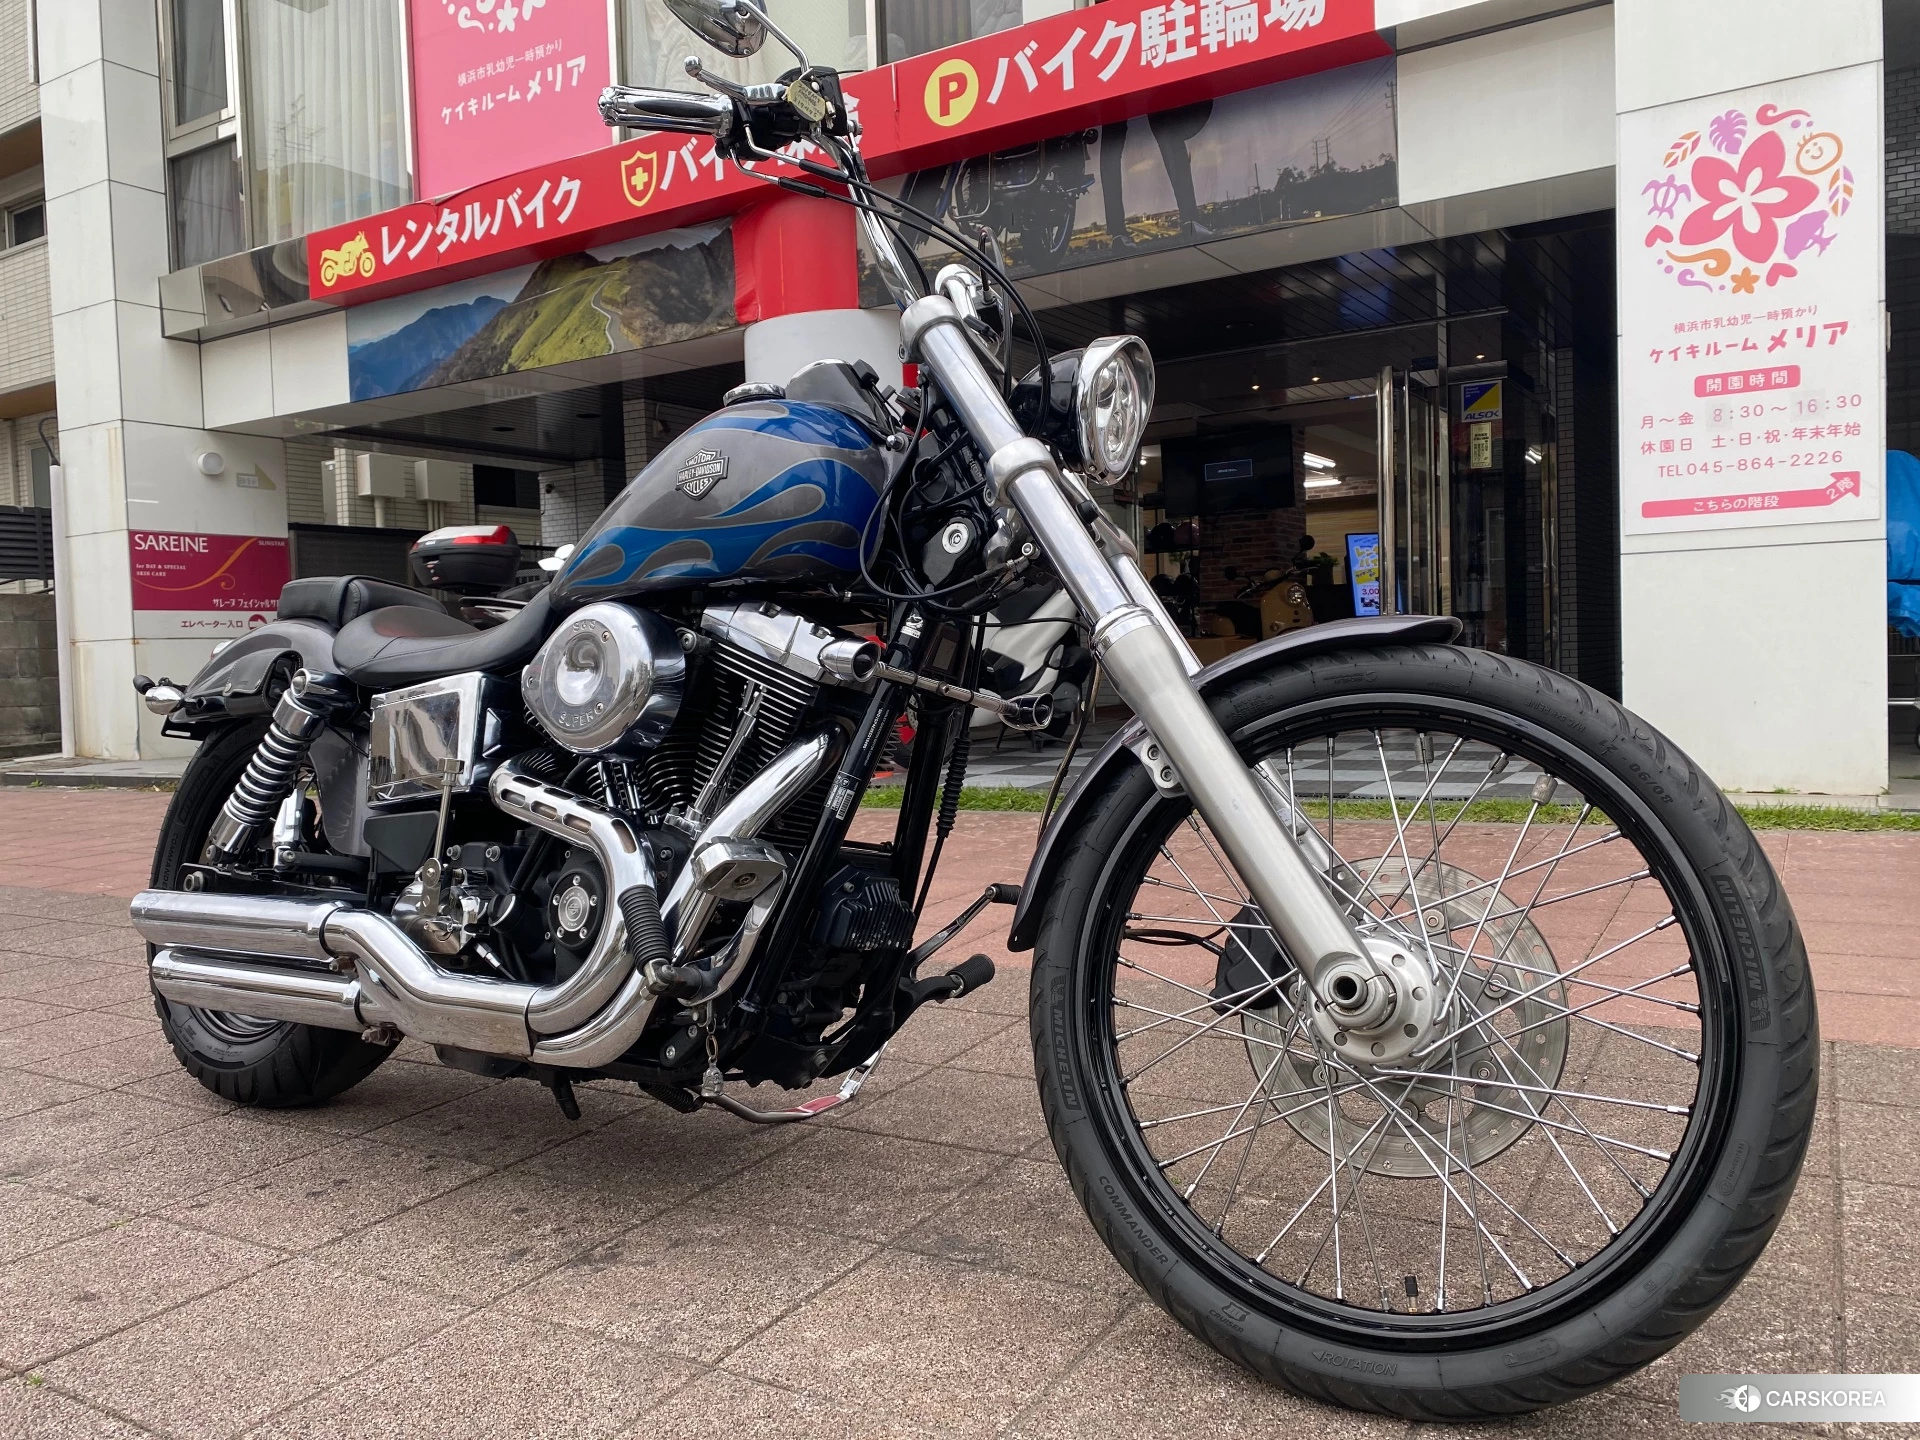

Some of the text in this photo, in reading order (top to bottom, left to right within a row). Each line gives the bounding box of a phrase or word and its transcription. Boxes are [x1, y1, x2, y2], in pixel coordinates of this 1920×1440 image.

[457, 38, 562, 87] 横浜市乳幼児一時預かり
[381, 175, 582, 266] レンタルバイク
[1673, 304, 1818, 334] 横浜市乳幼児一時預かり
[1706, 370, 1788, 393] 開園時間
[1640, 437, 1693, 455] 休園日
[686, 478, 709, 494] CYCLES
[1692, 495, 1780, 513] こちらの階段
[134, 533, 209, 553] SAREINE
[181, 619, 244, 629] エレベーター入口
[1716, 880, 1763, 992] MICHELIN
[1053, 1008, 1078, 1110] MICHELIN
[1099, 1174, 1169, 1265] COMMANDER
[1208, 1309, 1245, 1334] CRUISER
[1322, 1351, 1397, 1376] ROTATION
